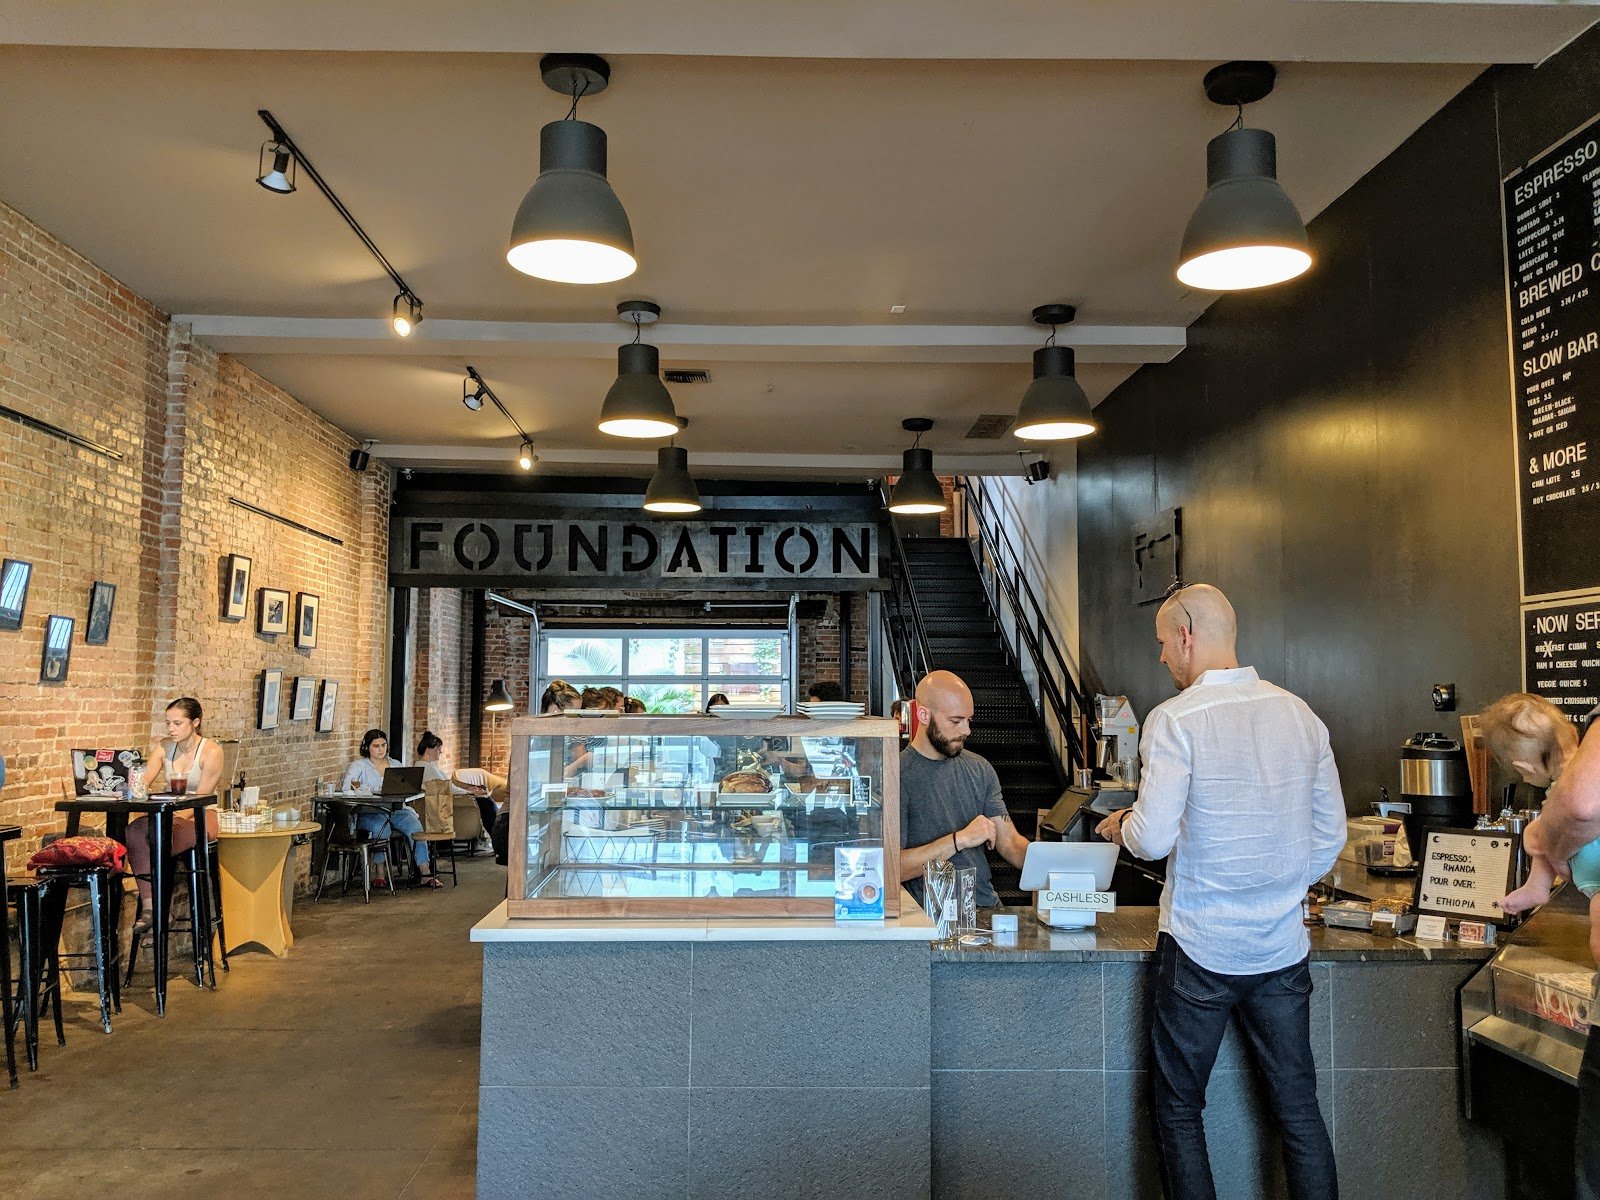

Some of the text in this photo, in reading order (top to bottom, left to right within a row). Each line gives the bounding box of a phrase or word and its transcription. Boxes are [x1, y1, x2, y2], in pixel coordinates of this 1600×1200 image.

[1514, 140, 1598, 206] ESPRESSO
[1516, 205, 1537, 222] DOUBLE
[1538, 196, 1553, 210] SHOT
[1516, 216, 1540, 235] CORTADO
[1517, 224, 1550, 248] CAPPUCCINO
[1518, 246, 1535, 260] LATTE
[1518, 246, 1558, 273] AMERICANO 3
[1522, 259, 1559, 284] HOT OR ICED
[1519, 263, 1583, 309] BREWED
[1520, 314, 1535, 326] COLD
[1535, 306, 1551, 319] BREW
[1522, 326, 1537, 338] NITRO
[1522, 340, 1535, 350] DRIP
[1523, 332, 1598, 377] SLOW BAR
[1526, 384, 1540, 395] POUR
[1540, 378, 1555, 389] OVER
[1527, 397, 1540, 407] TEAS
[1533, 421, 1568, 438] HOT OR ICED
[1529, 442, 1588, 475] & MORE
[1531, 479, 1545, 488] CHAI
[1546, 475, 1561, 485] LATTE
[1532, 496, 1544, 506] HOT
[1546, 488, 1576, 502] CHOCOLATE
[410, 522, 871, 574] FOUNDATION
[1536, 614, 1569, 635] NOW
[1568, 642, 1587, 651] CUBAN
[1536, 662, 1548, 670] HAM
[1556, 660, 1577, 669] CHEESE
[1537, 680, 1557, 688] VEGGIE
[1564, 697, 1598, 705] CROISSANTS
[1432, 852, 1472, 864] ESPRESSO:
[1443, 863, 1476, 874] RWANDA
[1430, 876, 1476, 889] POUR OVER:
[1046, 891, 1109, 904] CASHLESS
